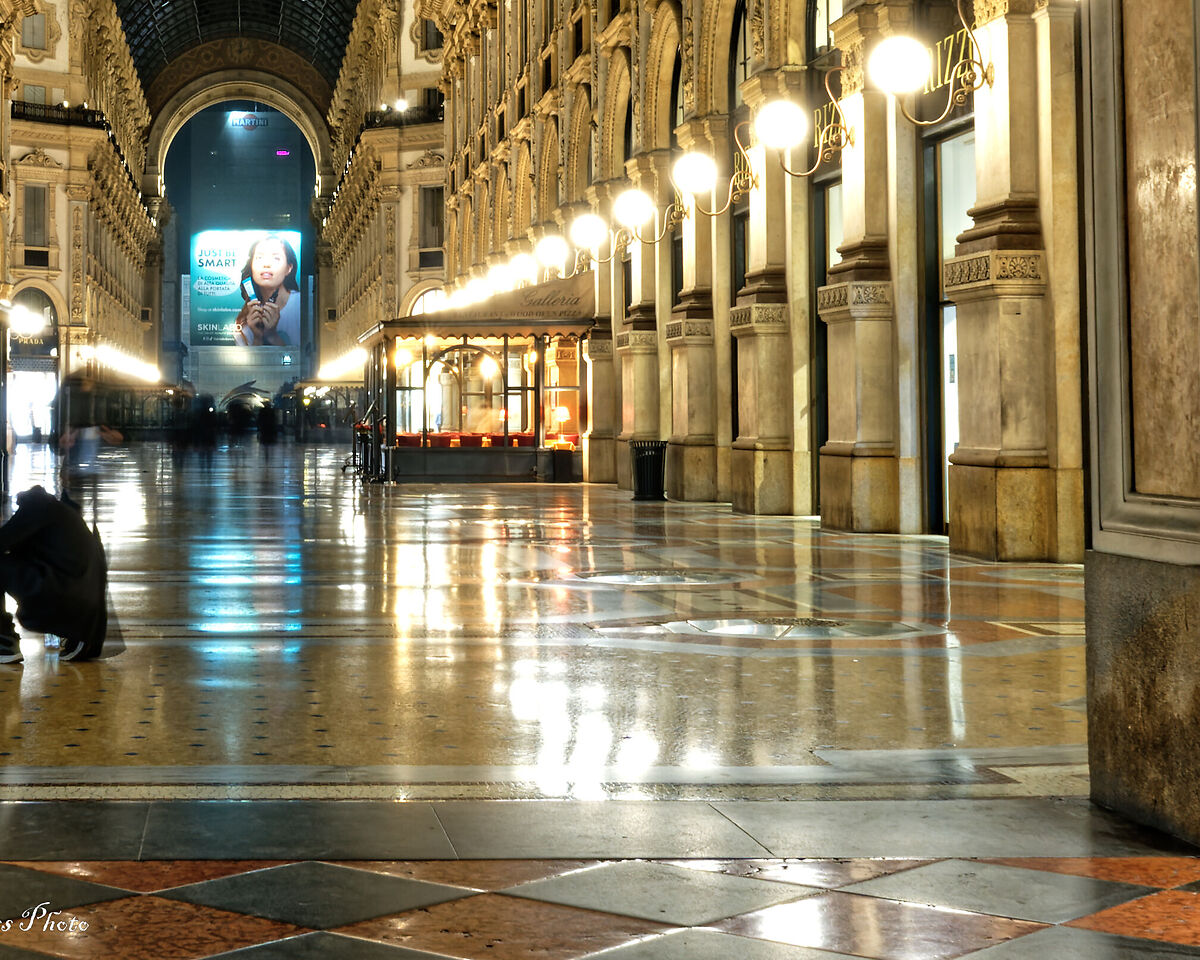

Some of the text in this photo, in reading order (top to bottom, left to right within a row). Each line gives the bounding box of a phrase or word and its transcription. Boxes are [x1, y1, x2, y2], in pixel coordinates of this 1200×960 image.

[232, 118, 268, 126] MARTINI
[198, 249, 221, 257] JUST
[198, 258, 236, 267] SMART
[520, 289, 580, 307] Galleria
[197, 323, 242, 331] SKINLABO
